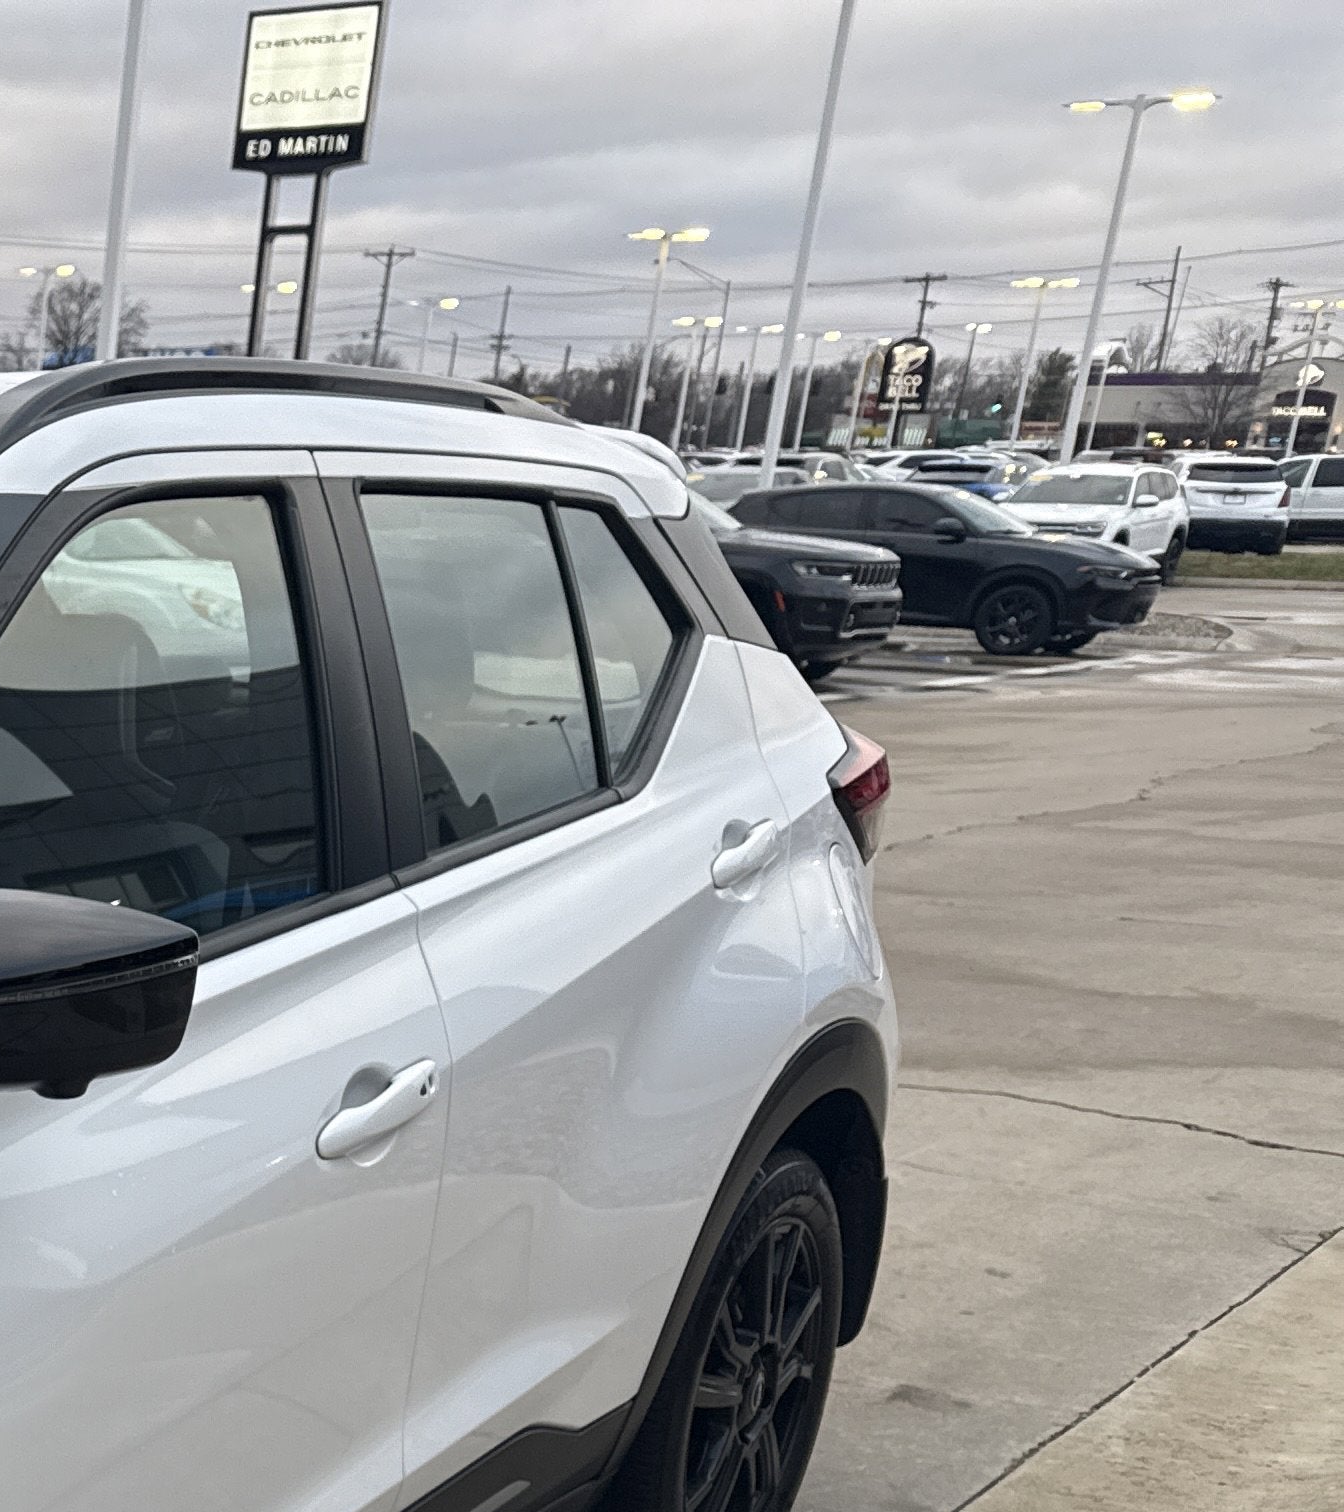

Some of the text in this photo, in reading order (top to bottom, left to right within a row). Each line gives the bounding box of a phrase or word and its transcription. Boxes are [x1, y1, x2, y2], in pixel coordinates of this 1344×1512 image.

[254, 31, 367, 50] CHEVROLET
[249, 85, 361, 106] CADILLAC
[246, 133, 350, 160] ED MARTIN
